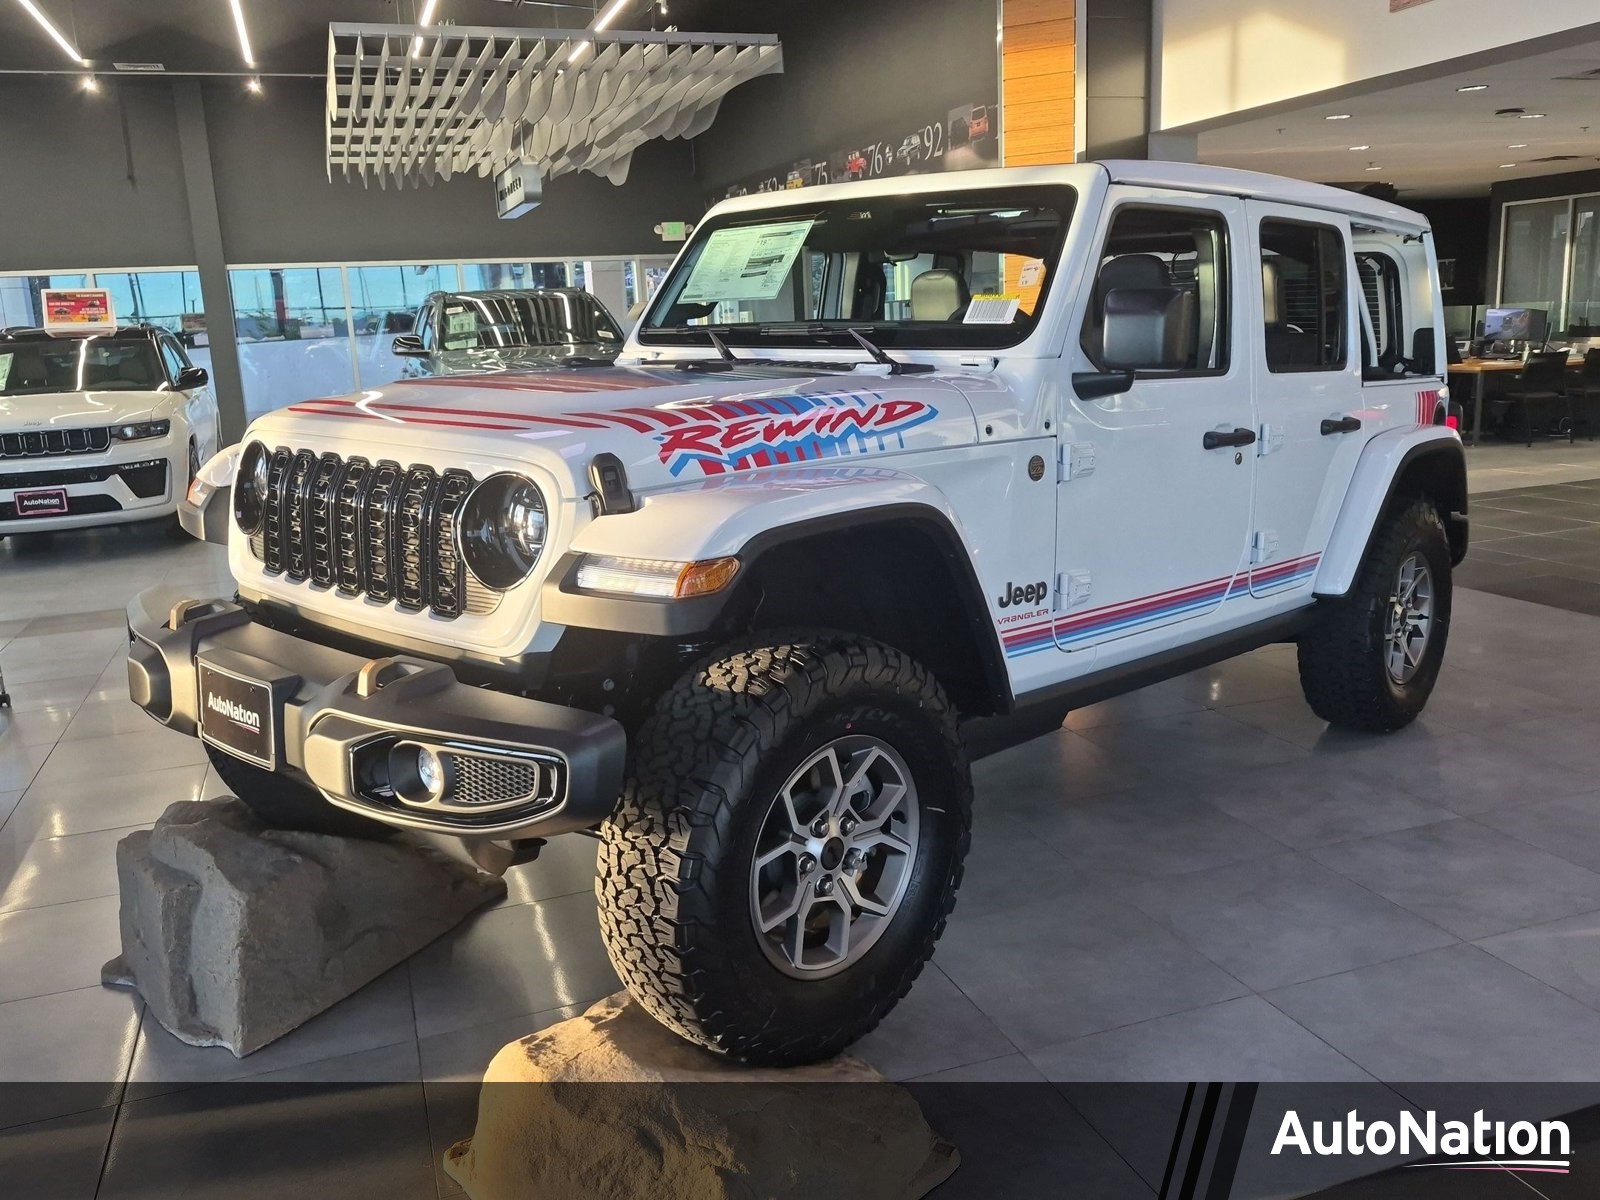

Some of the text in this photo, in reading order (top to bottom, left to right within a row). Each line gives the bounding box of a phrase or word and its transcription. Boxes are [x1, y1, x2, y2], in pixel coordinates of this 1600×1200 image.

[659, 400, 925, 464] REWIND
[23, 497, 60, 506] AutoNation
[998, 581, 1048, 608] Jeep
[997, 608, 1049, 625] WRANGLER
[208, 691, 260, 728] AutoNation
